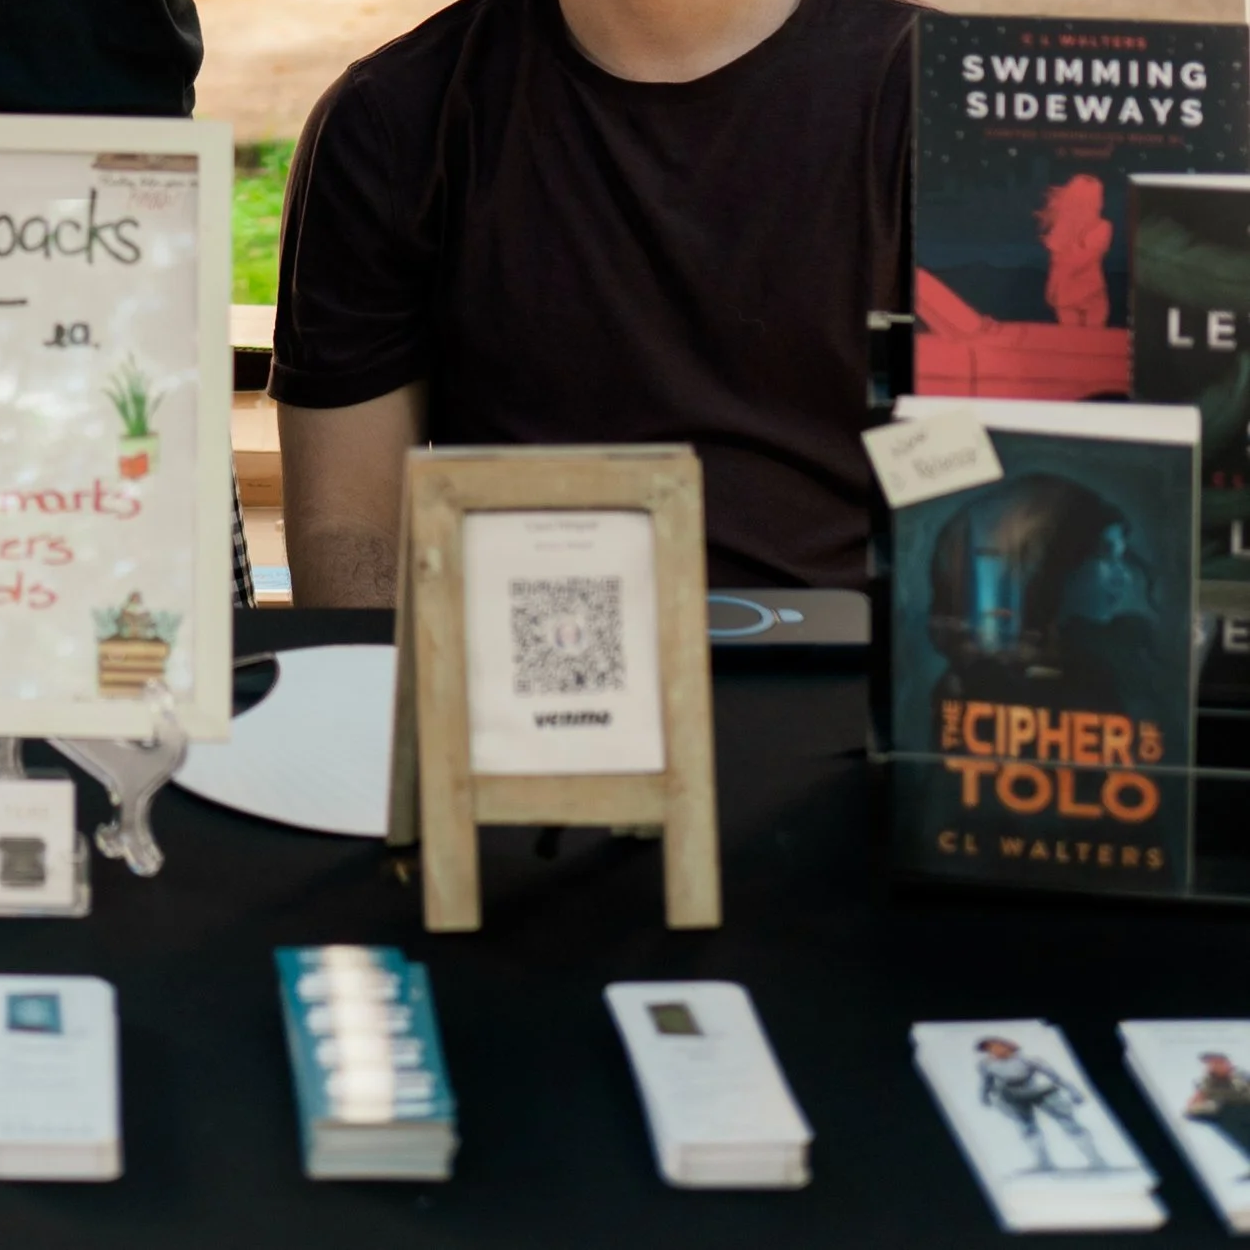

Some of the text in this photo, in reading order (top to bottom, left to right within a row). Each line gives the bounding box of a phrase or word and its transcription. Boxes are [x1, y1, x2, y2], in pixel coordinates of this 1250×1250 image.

[961, 54, 1207, 91] SWIMMING
[965, 91, 1204, 128] SIDEWAYS
[962, 701, 1135, 768] CIPHER
[1138, 721, 1164, 763] OF
[944, 755, 1161, 824] TOLO
[1000, 836, 1165, 871] WALTERS
